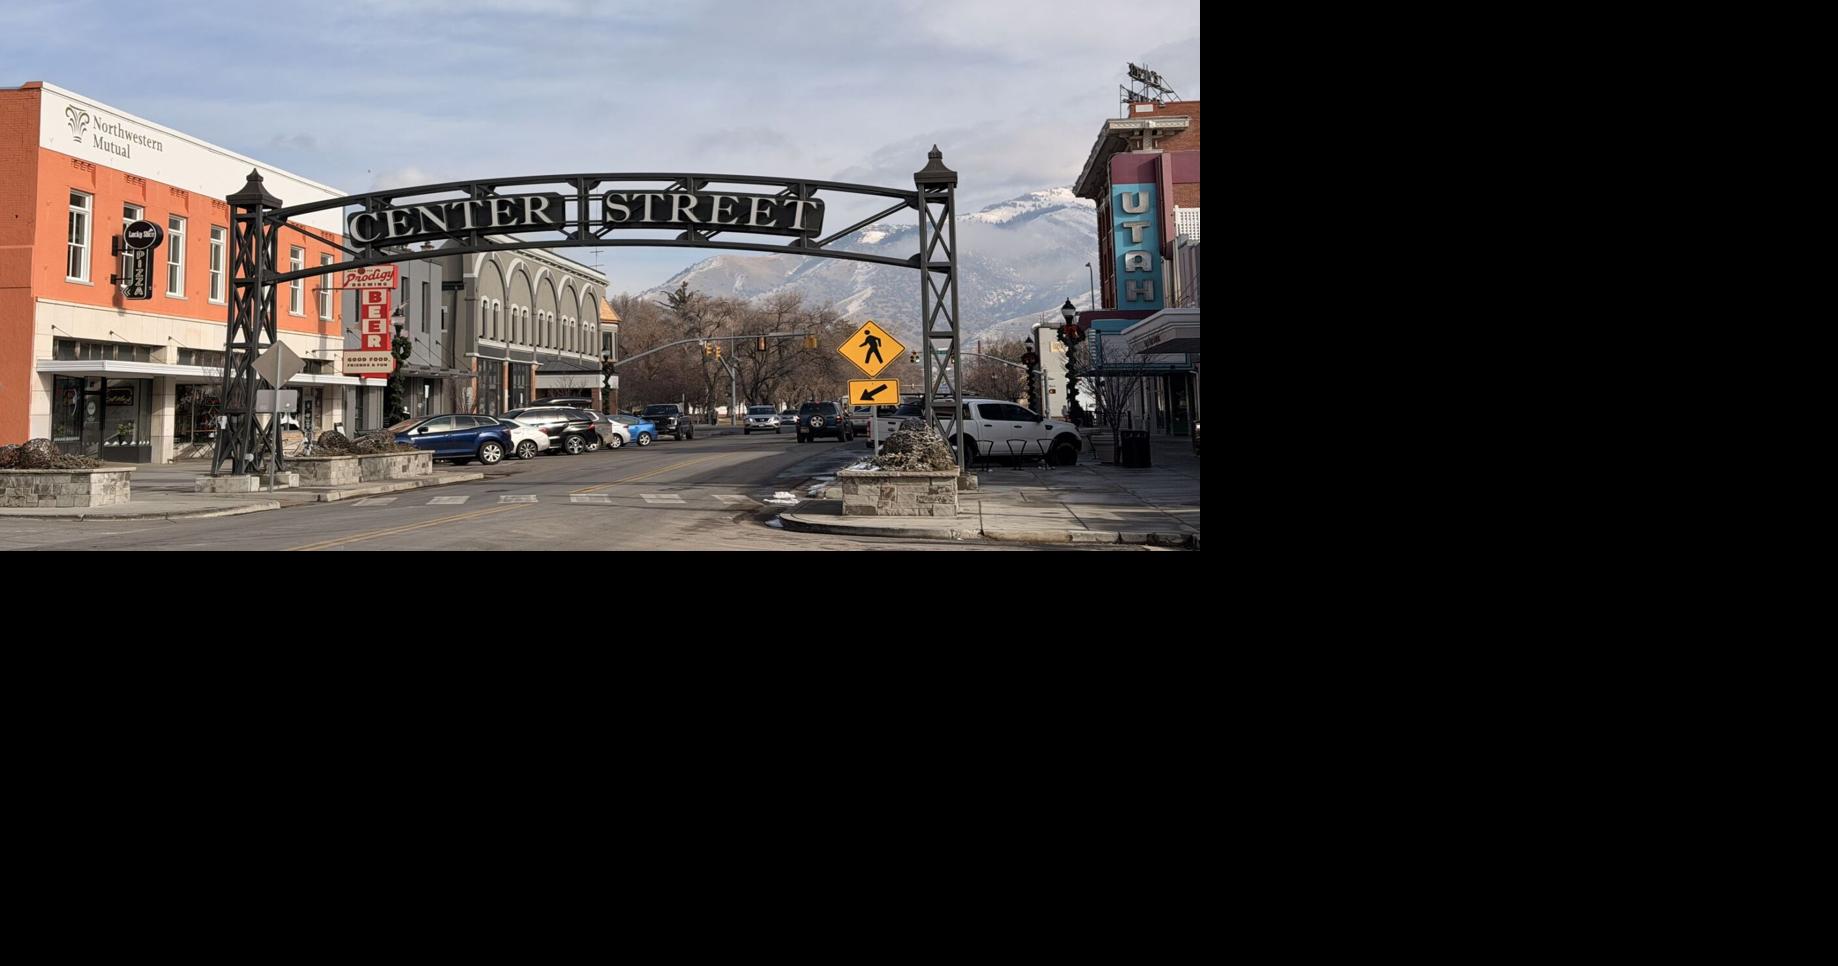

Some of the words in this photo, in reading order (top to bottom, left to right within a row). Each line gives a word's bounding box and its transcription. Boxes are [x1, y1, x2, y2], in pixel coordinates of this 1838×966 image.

[93, 115, 163, 152] Northwestern
[93, 133, 131, 159] Mutual
[349, 195, 555, 244] CENTER
[605, 192, 818, 232] STREET
[1121, 192, 1154, 302] UTAH
[134, 250, 145, 296] PIZZA
[343, 269, 394, 287] Prodigy
[367, 290, 382, 348] BEER
